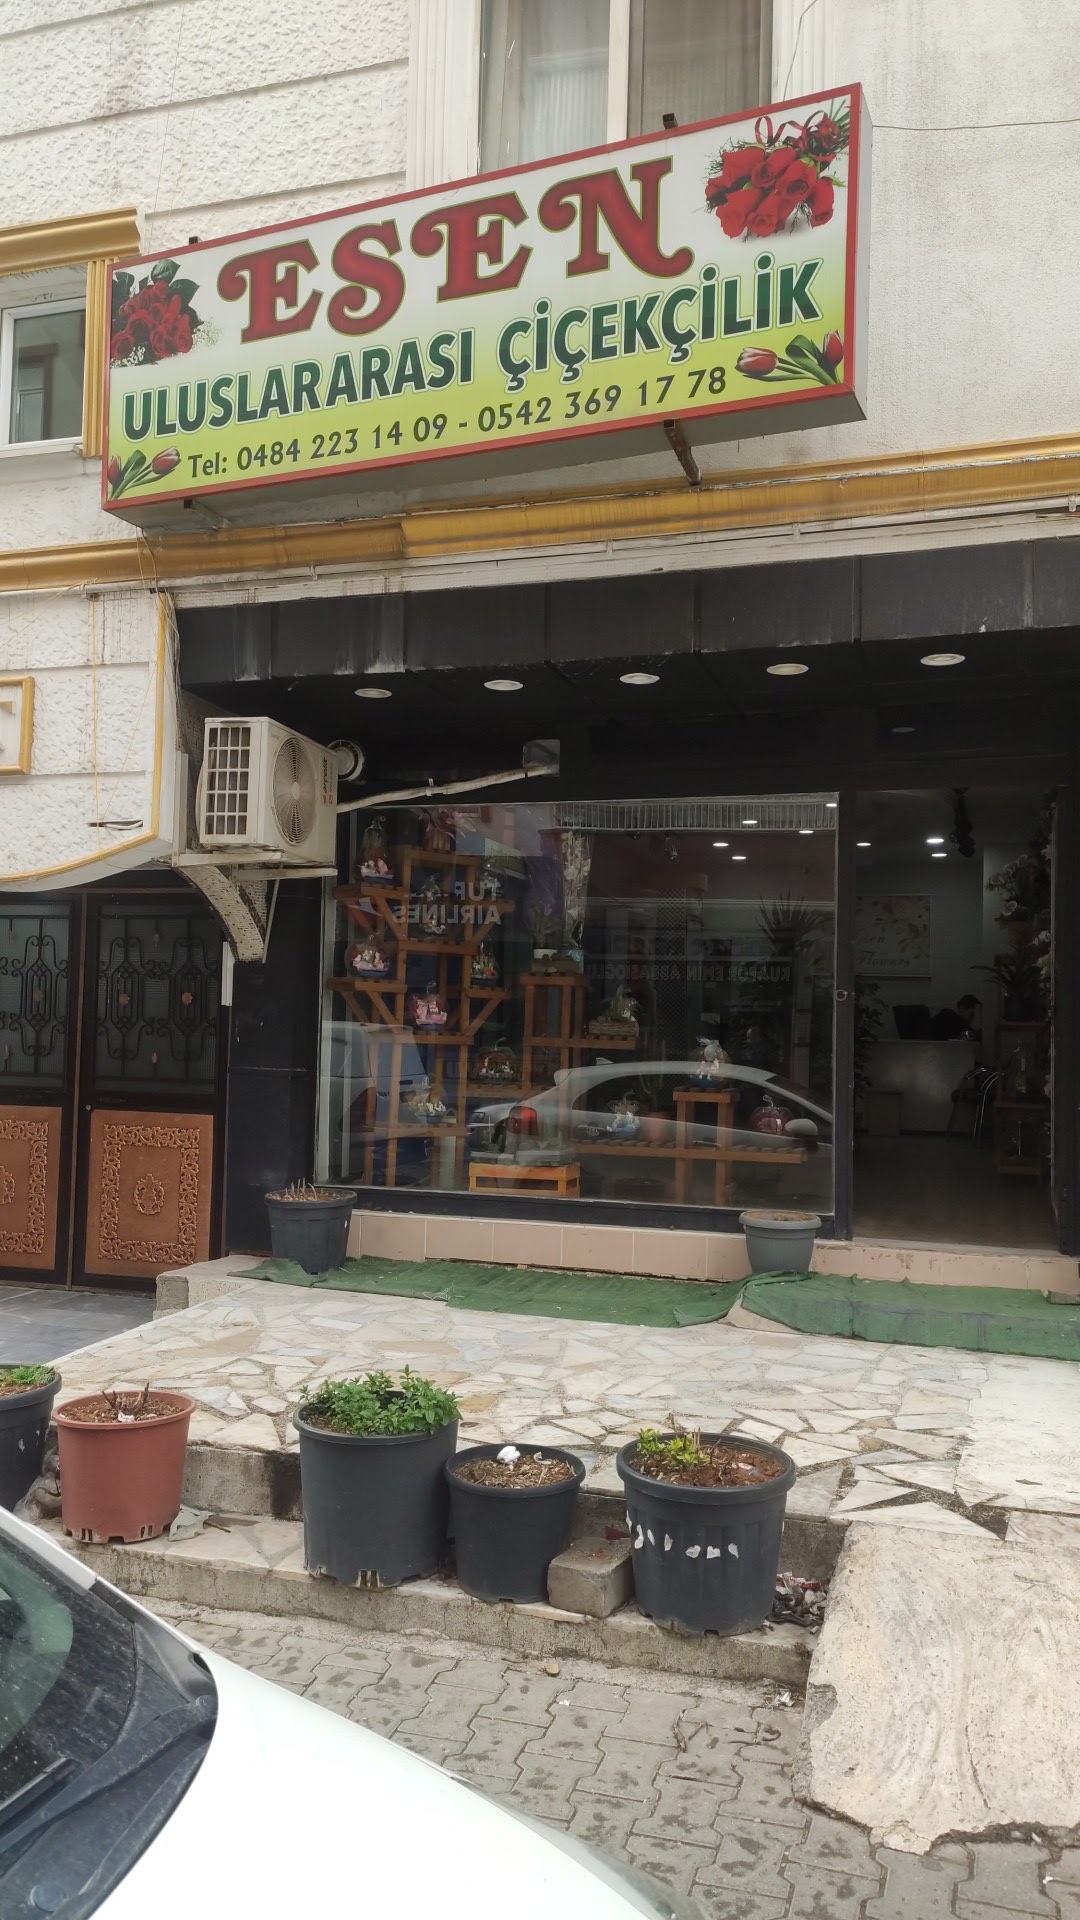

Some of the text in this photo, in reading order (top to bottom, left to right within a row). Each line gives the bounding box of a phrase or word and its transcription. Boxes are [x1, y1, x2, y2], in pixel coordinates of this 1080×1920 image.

[217, 156, 694, 344] ESEN
[122, 253, 822, 442] ULUSLARARASI ÇİÇEKÇİLİK
[187, 451, 228, 478] Tel:
[237, 438, 300, 471] 0484
[310, 427, 359, 460] 223
[372, 420, 403, 449] 14
[413, 413, 448, 443] 09
[478, 396, 552, 432] 0542
[564, 383, 622, 419] 369
[636, 375, 675, 407] 17
[687, 366, 727, 399] 78
